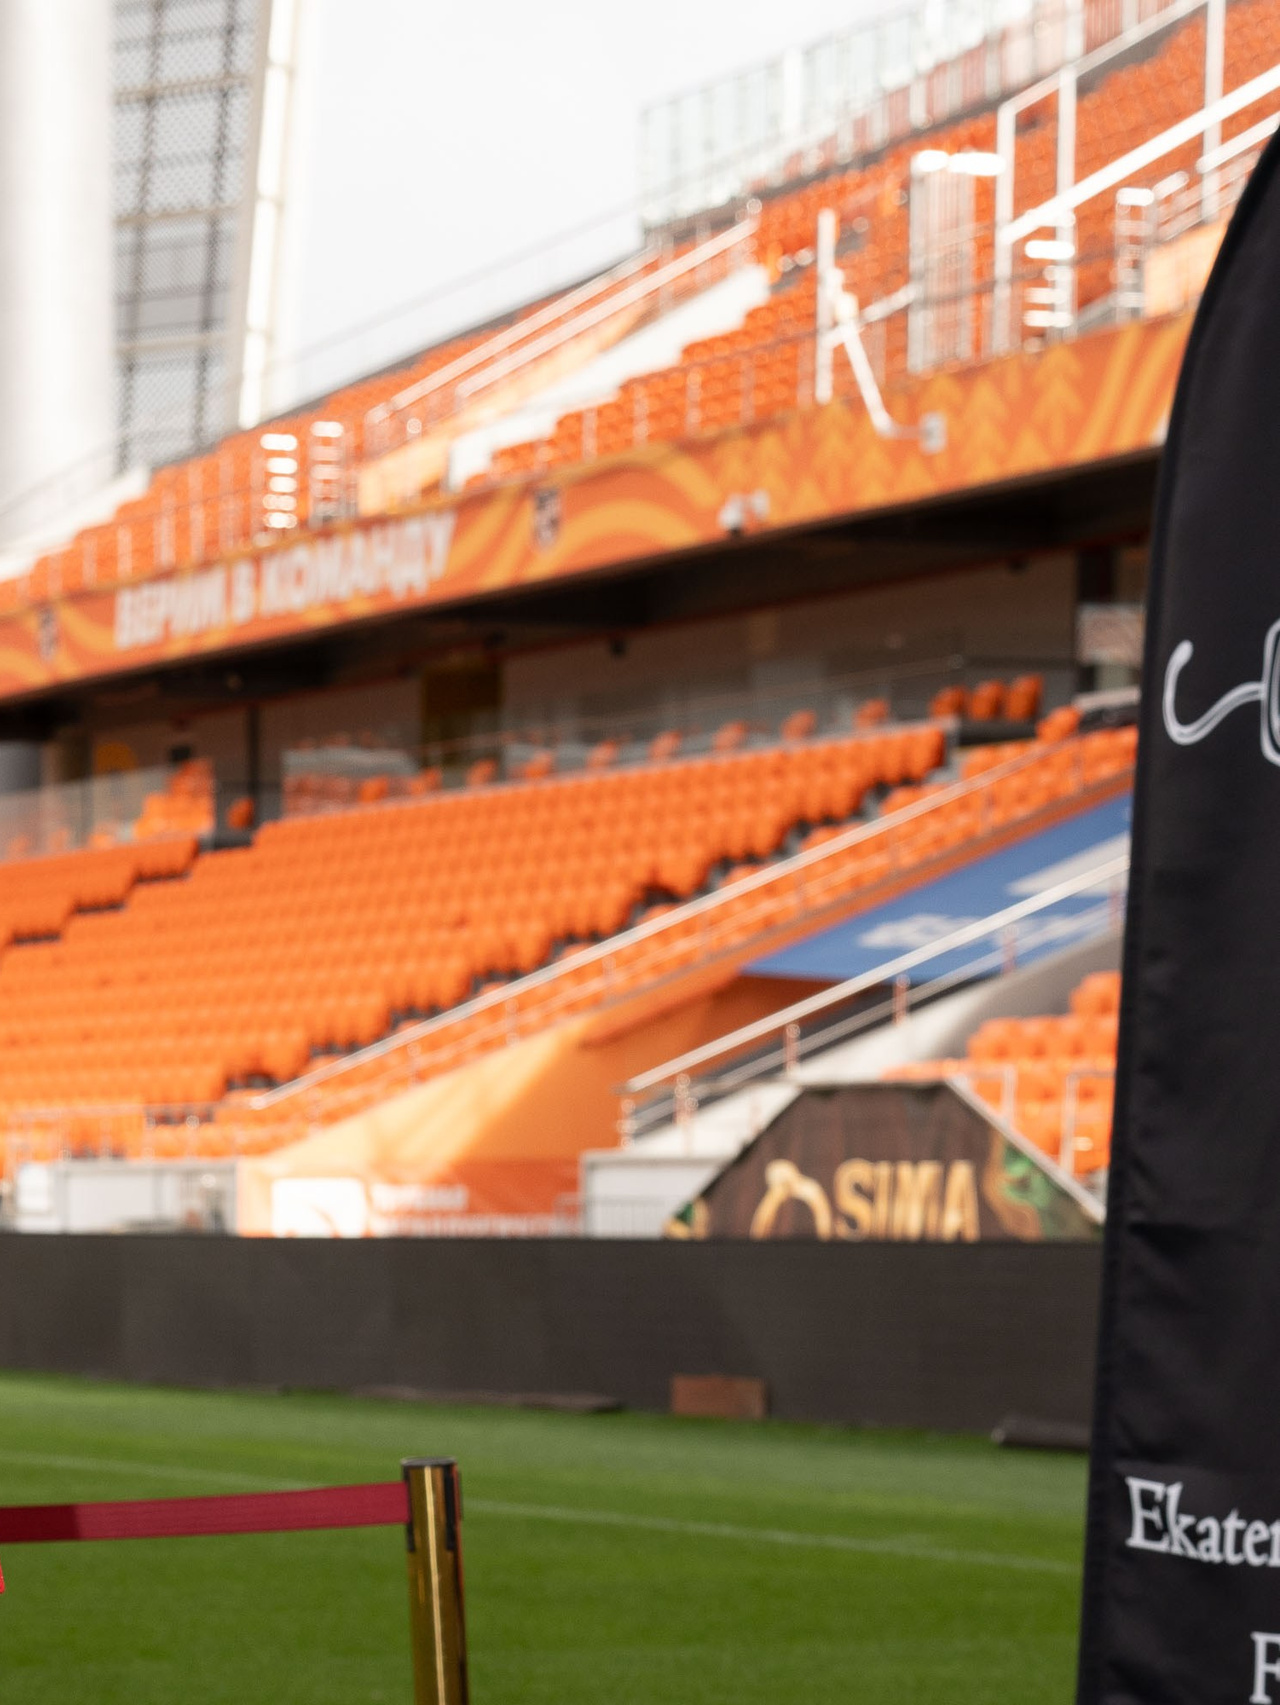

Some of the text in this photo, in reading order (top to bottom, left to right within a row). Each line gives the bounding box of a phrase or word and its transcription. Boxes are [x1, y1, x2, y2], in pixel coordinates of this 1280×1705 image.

[114, 511, 456, 648] ВЕРИМ В КОМАНДУ
[834, 1158, 980, 1241] SIMA
